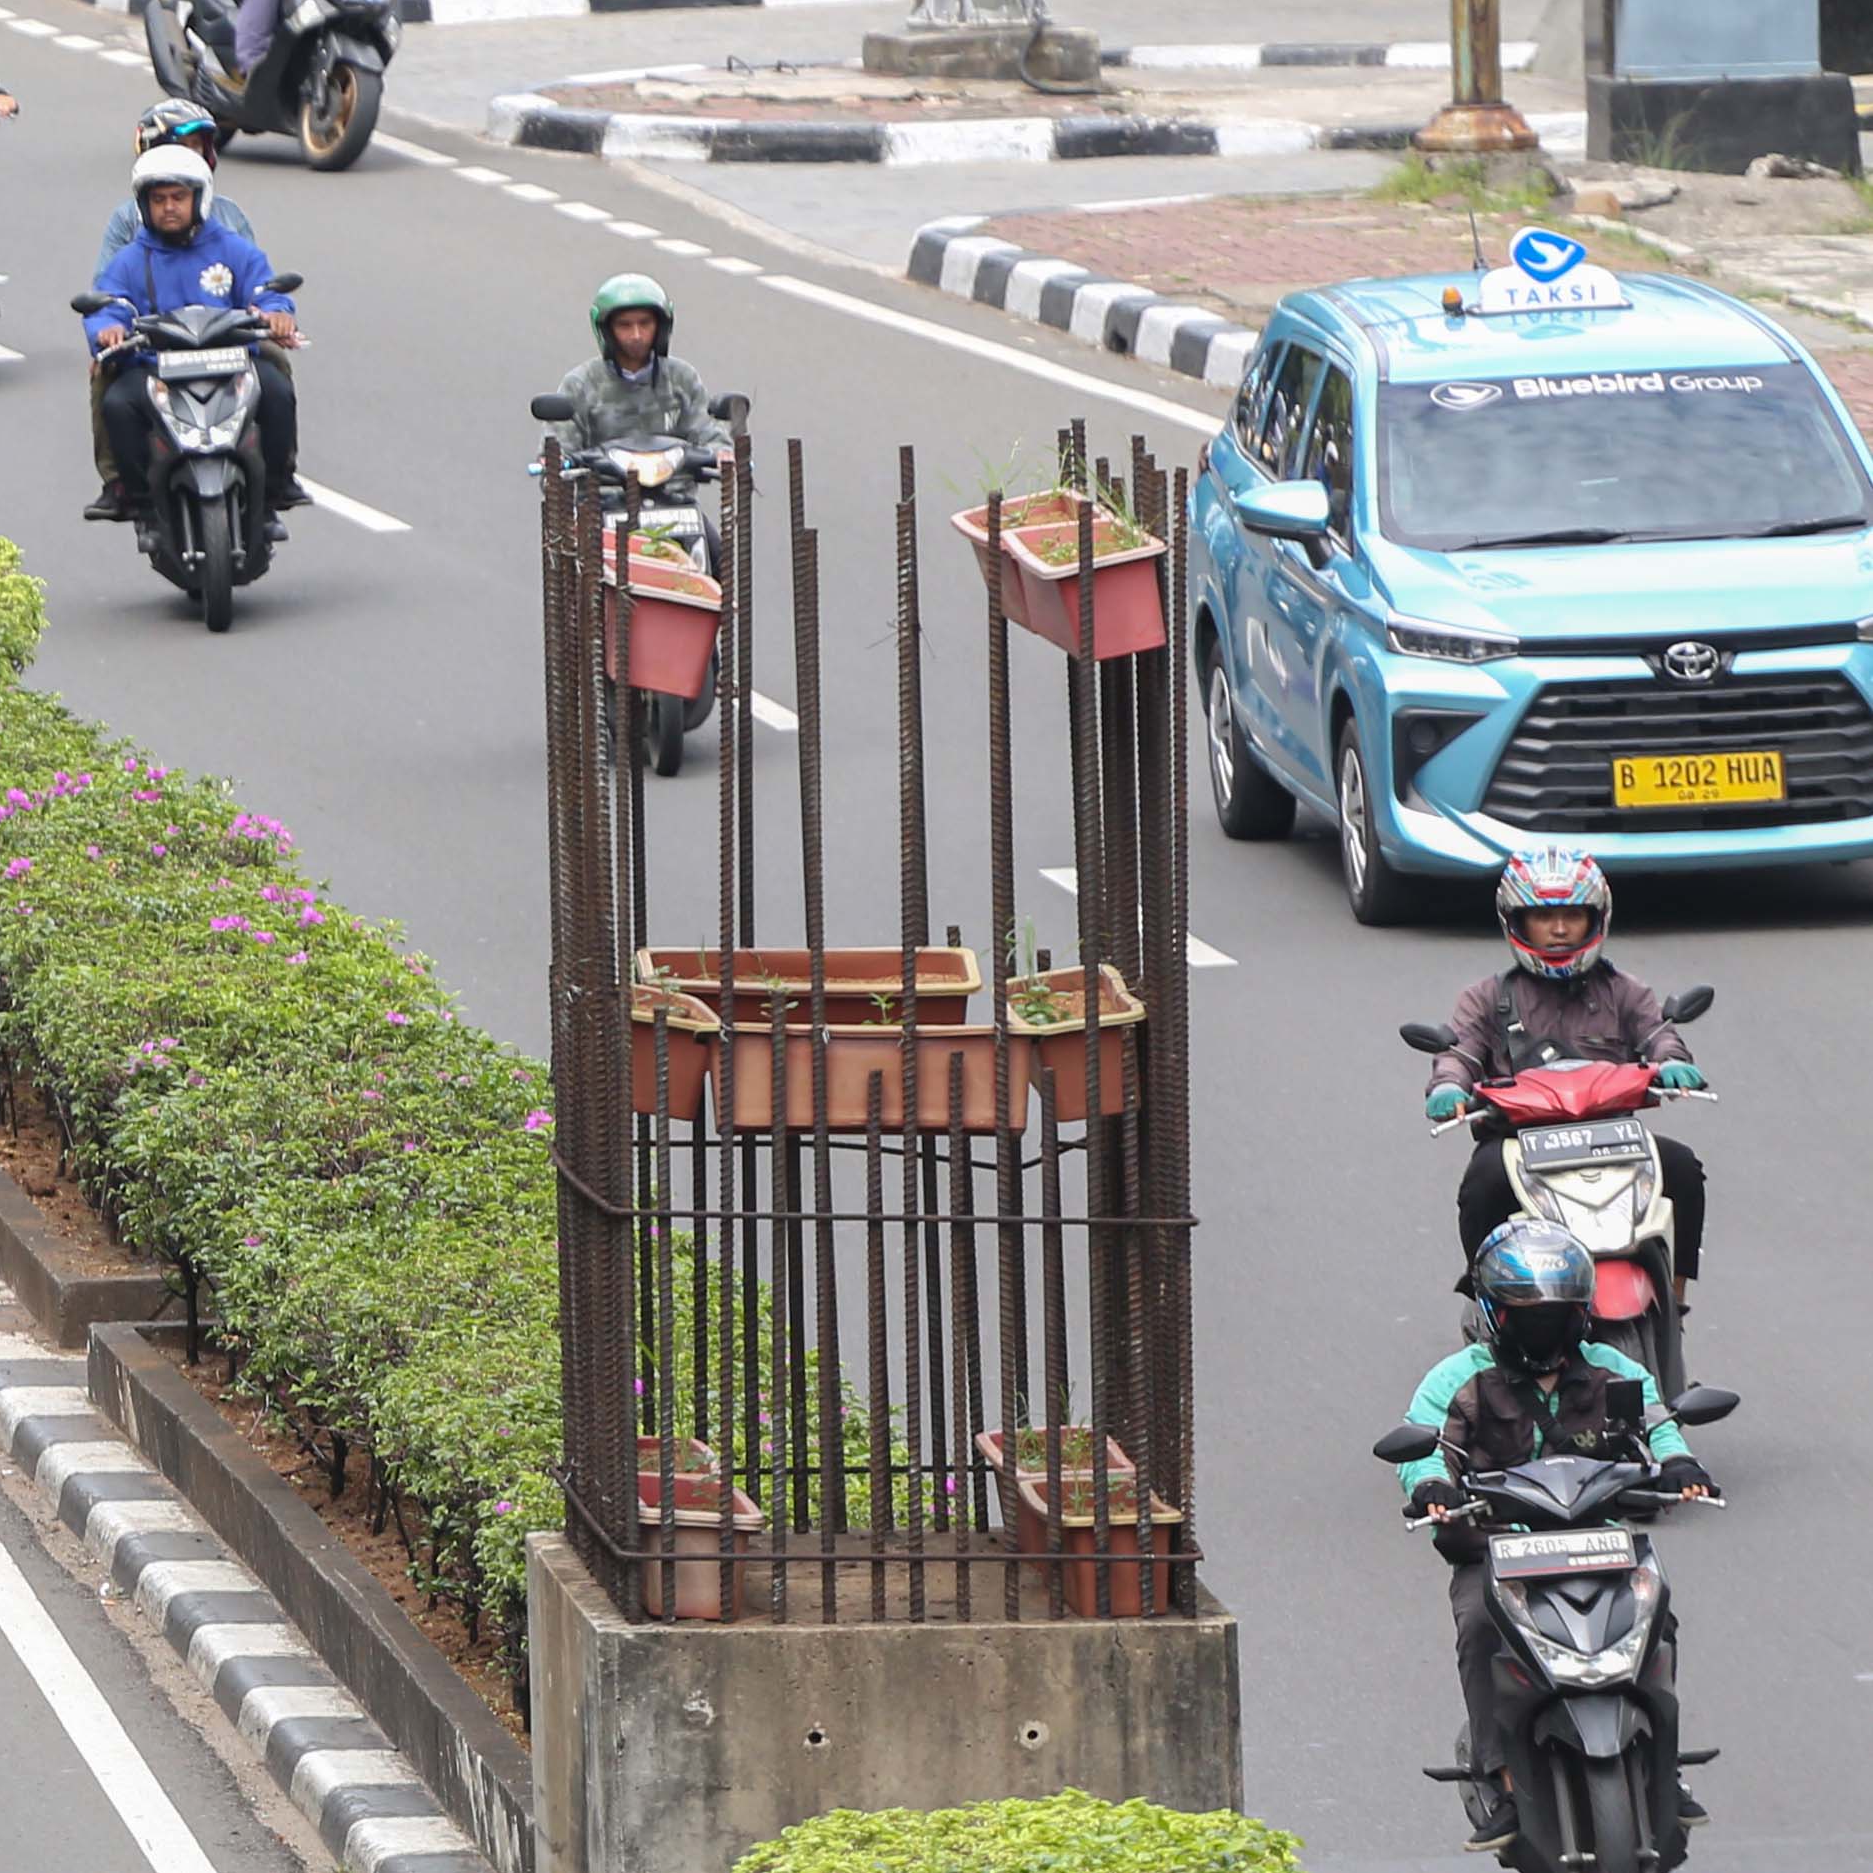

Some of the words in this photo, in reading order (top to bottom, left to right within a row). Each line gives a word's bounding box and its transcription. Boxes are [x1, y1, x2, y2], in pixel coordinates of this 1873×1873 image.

[1506, 285, 1597, 305] TAKSI
[1513, 373, 1664, 399] Bluebird
[1670, 375, 1763, 394] Group
[1621, 764, 1636, 789] B
[1654, 759, 1717, 788] 1202
[1727, 756, 1777, 785] HUA
[1527, 1135, 1537, 1152] T
[1614, 1123, 1639, 1142] YL
